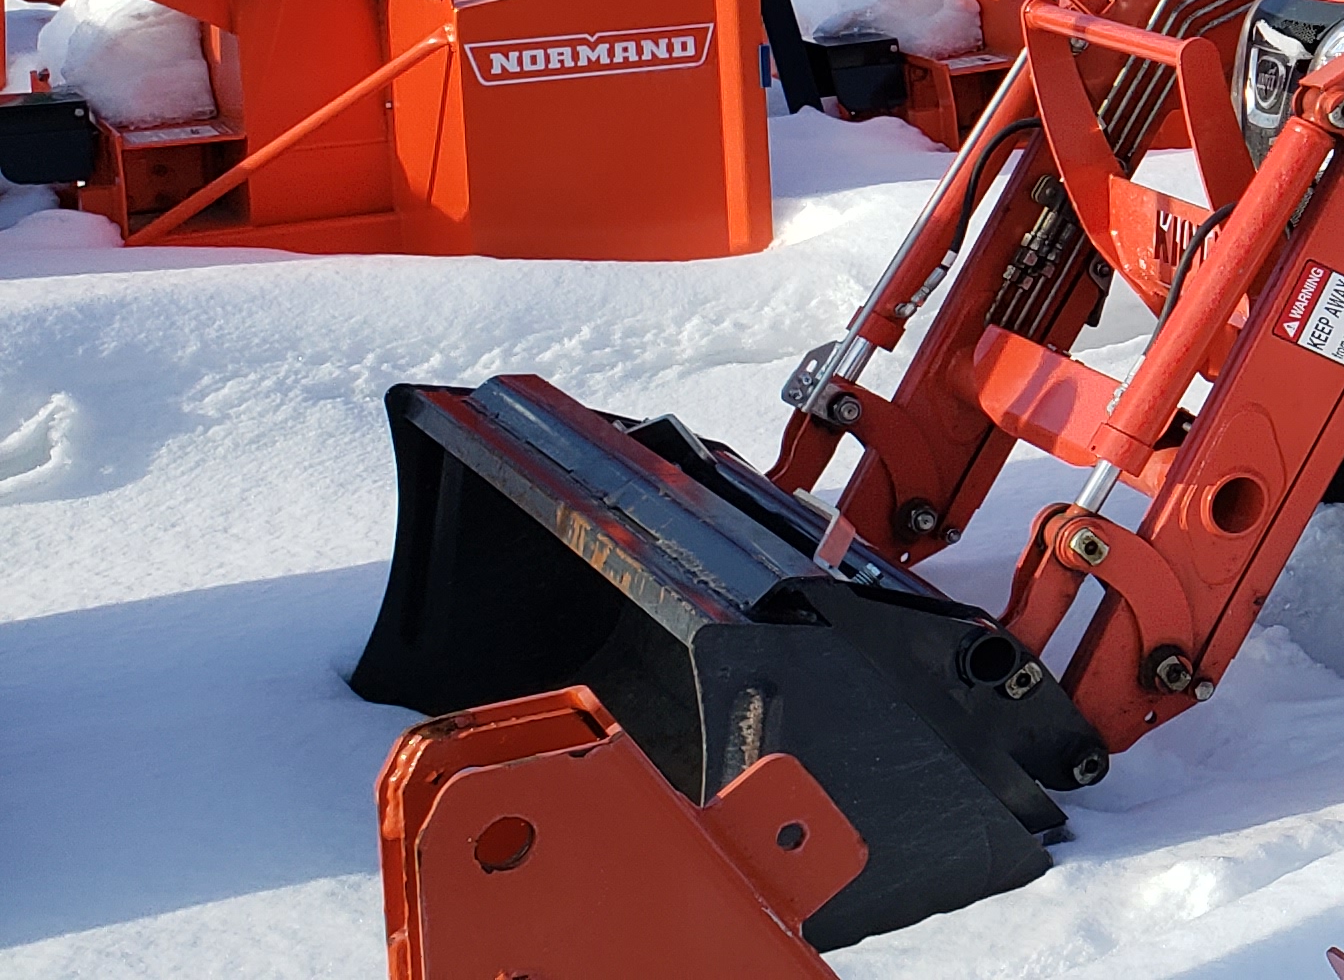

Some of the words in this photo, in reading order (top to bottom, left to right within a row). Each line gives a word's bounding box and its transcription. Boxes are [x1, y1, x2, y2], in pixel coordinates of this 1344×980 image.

[490, 35, 696, 75] NORMAND
[1289, 267, 1324, 319] WARNING
[1306, 316, 1335, 351] KEEP
